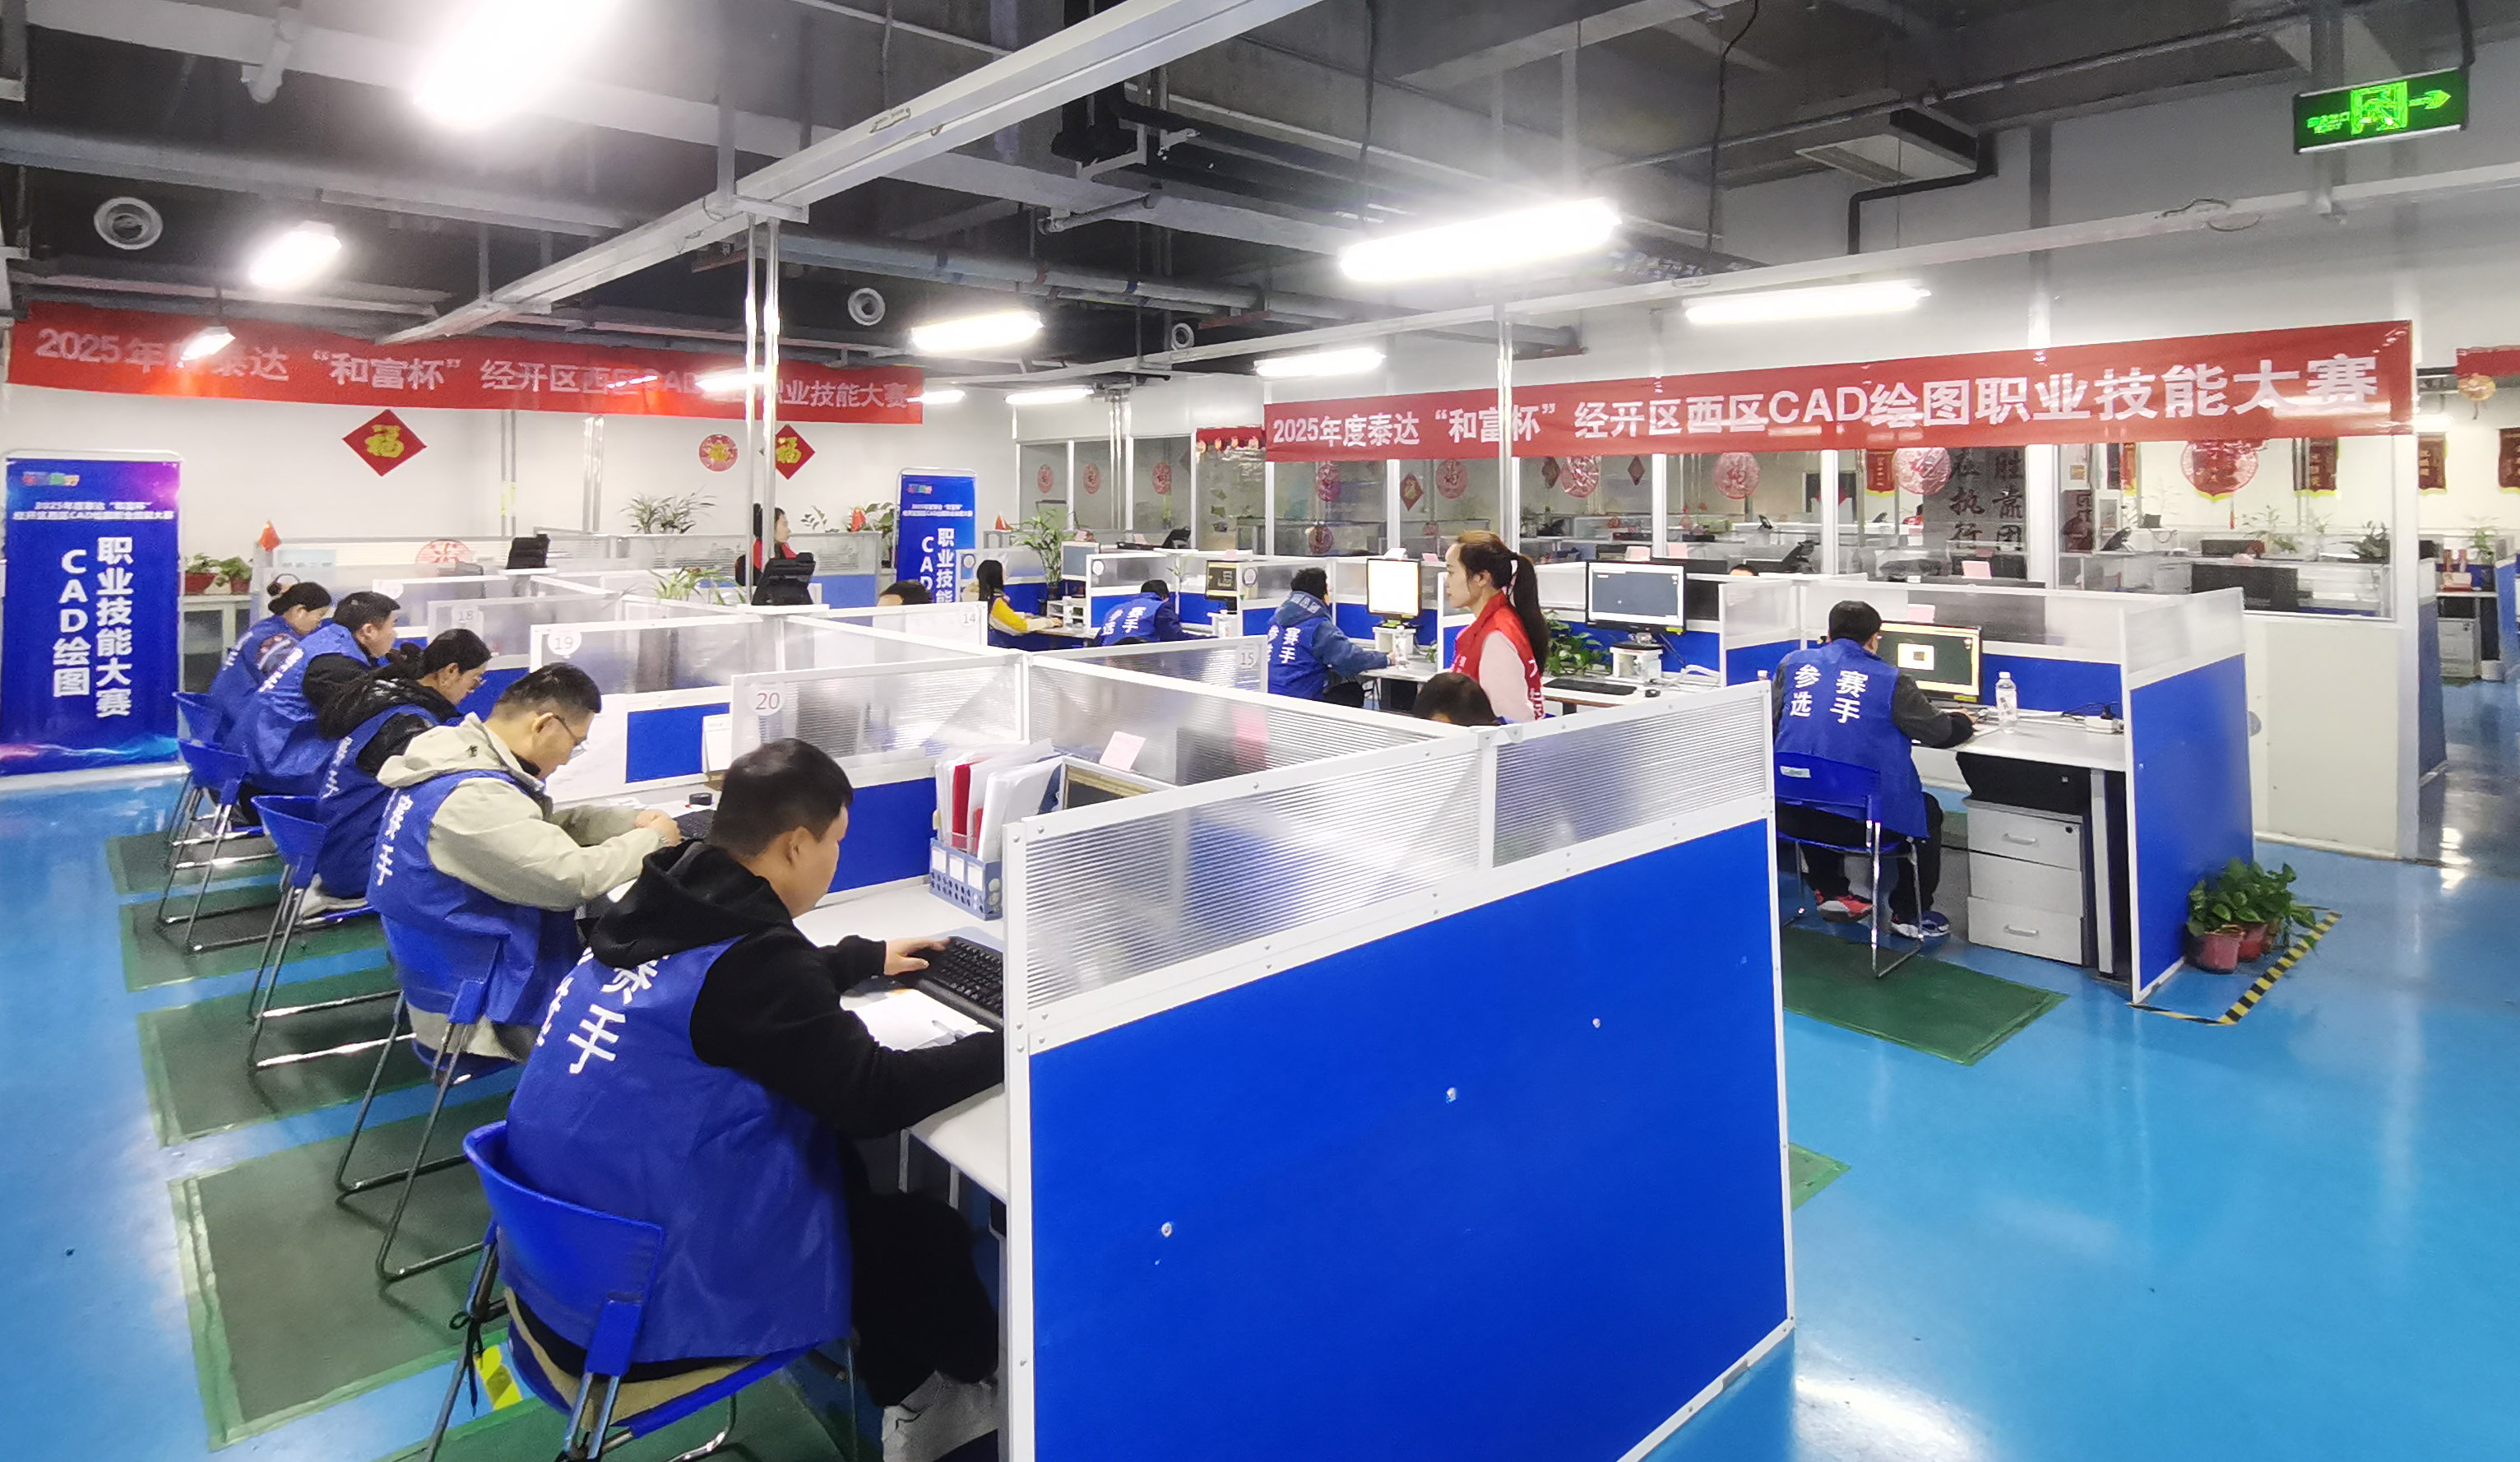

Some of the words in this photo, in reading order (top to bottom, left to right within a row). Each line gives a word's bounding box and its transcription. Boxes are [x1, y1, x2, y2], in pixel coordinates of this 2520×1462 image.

[35, 328, 289, 382] 2025年达
[1273, 411, 1420, 448] 2025年度泰达
[1434, 403, 1556, 443] “和富杯”
[1574, 353, 2378, 439] 经开区西区CAD绘图职业技能大赛
[53, 549, 91, 698] CAD绘图
[95, 536, 134, 718] 职业技能大赛
[554, 636, 574, 651] 19
[1240, 651, 1255, 665] 15
[755, 692, 781, 711] 20
